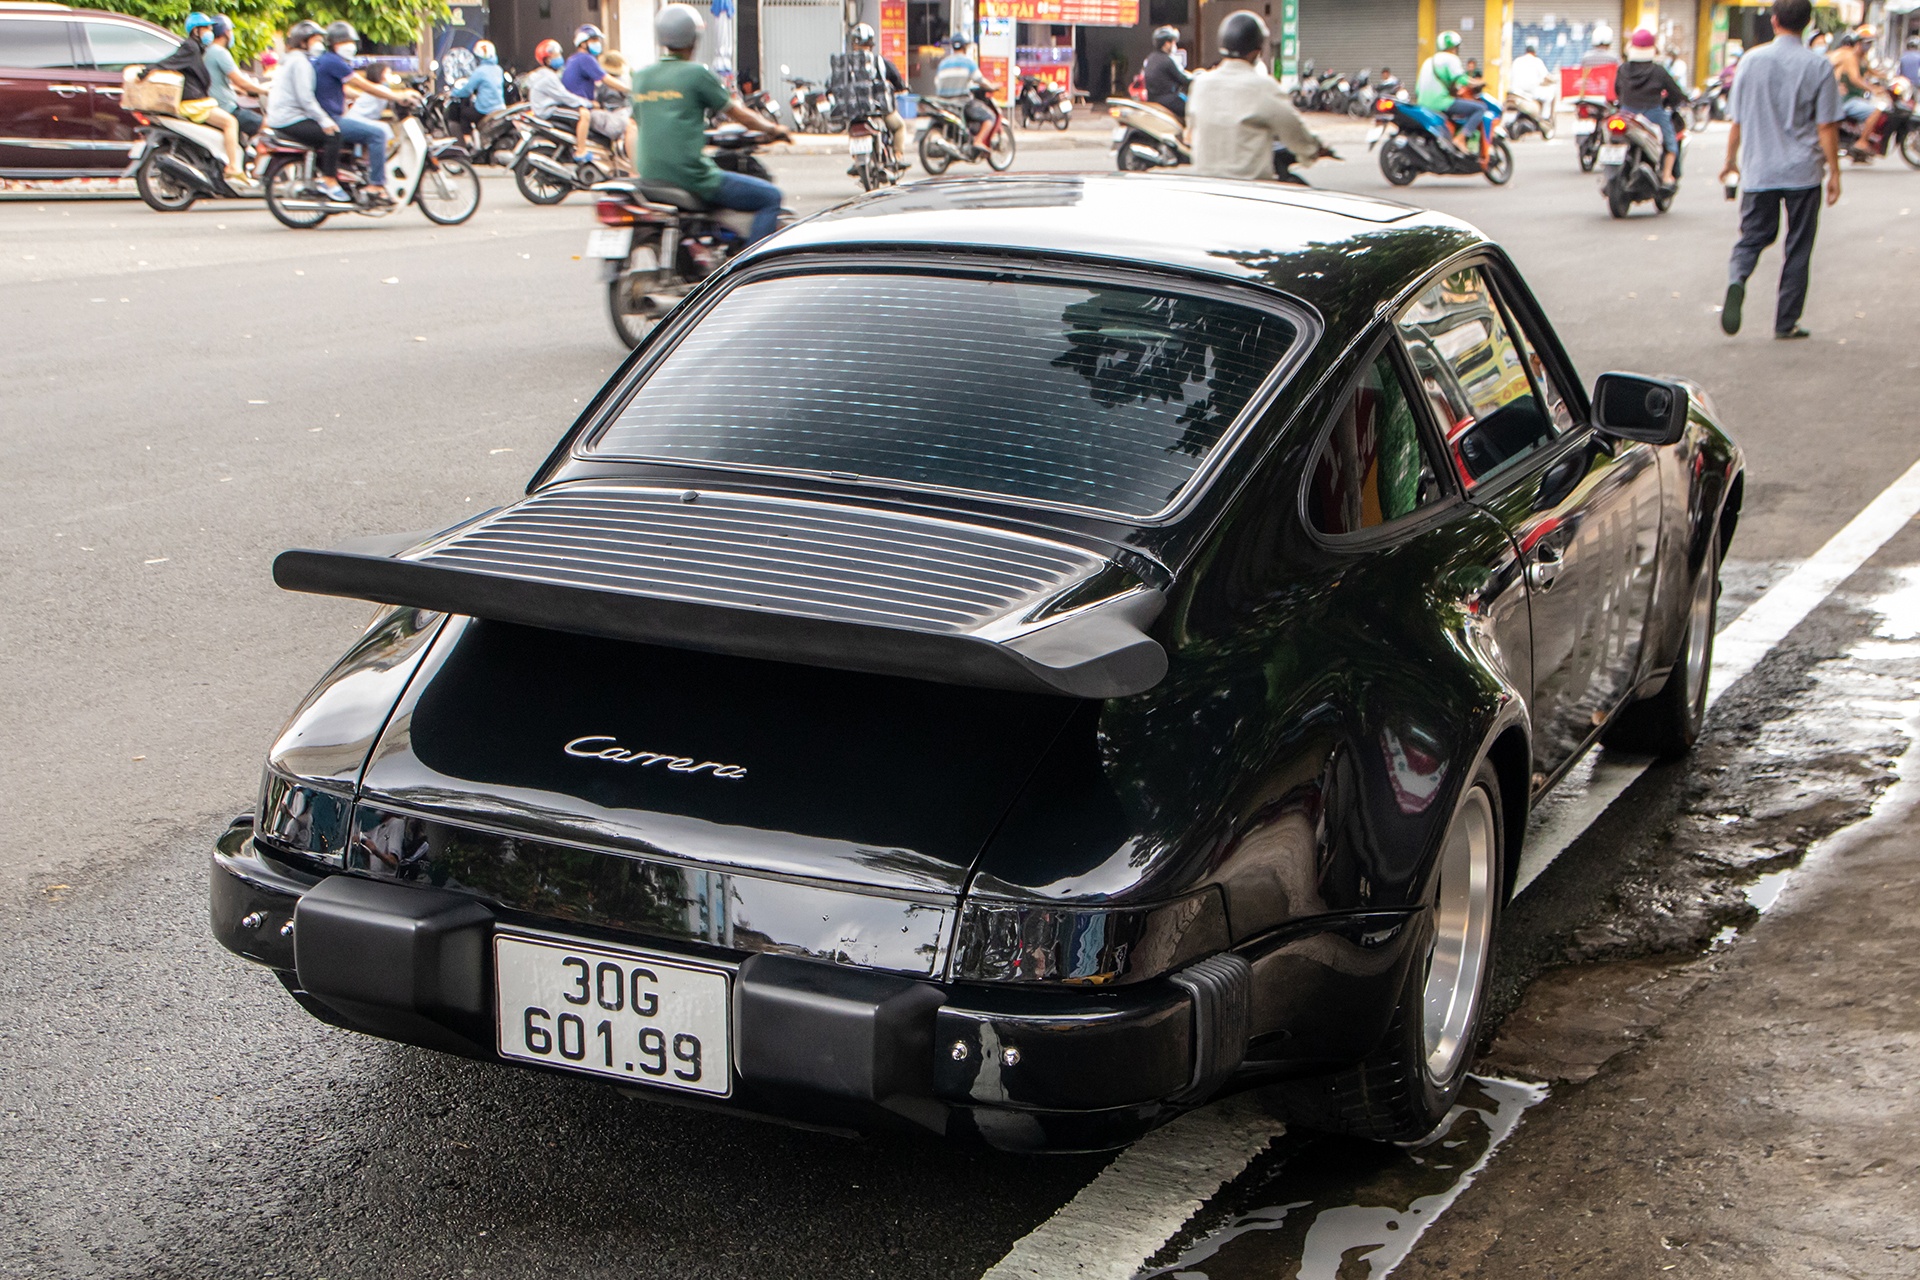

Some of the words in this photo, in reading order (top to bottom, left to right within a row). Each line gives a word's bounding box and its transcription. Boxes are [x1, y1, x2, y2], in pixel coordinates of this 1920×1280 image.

[564, 734, 748, 779] Carrera
[562, 956, 659, 1018] 30G
[524, 1006, 702, 1083] 601.99
